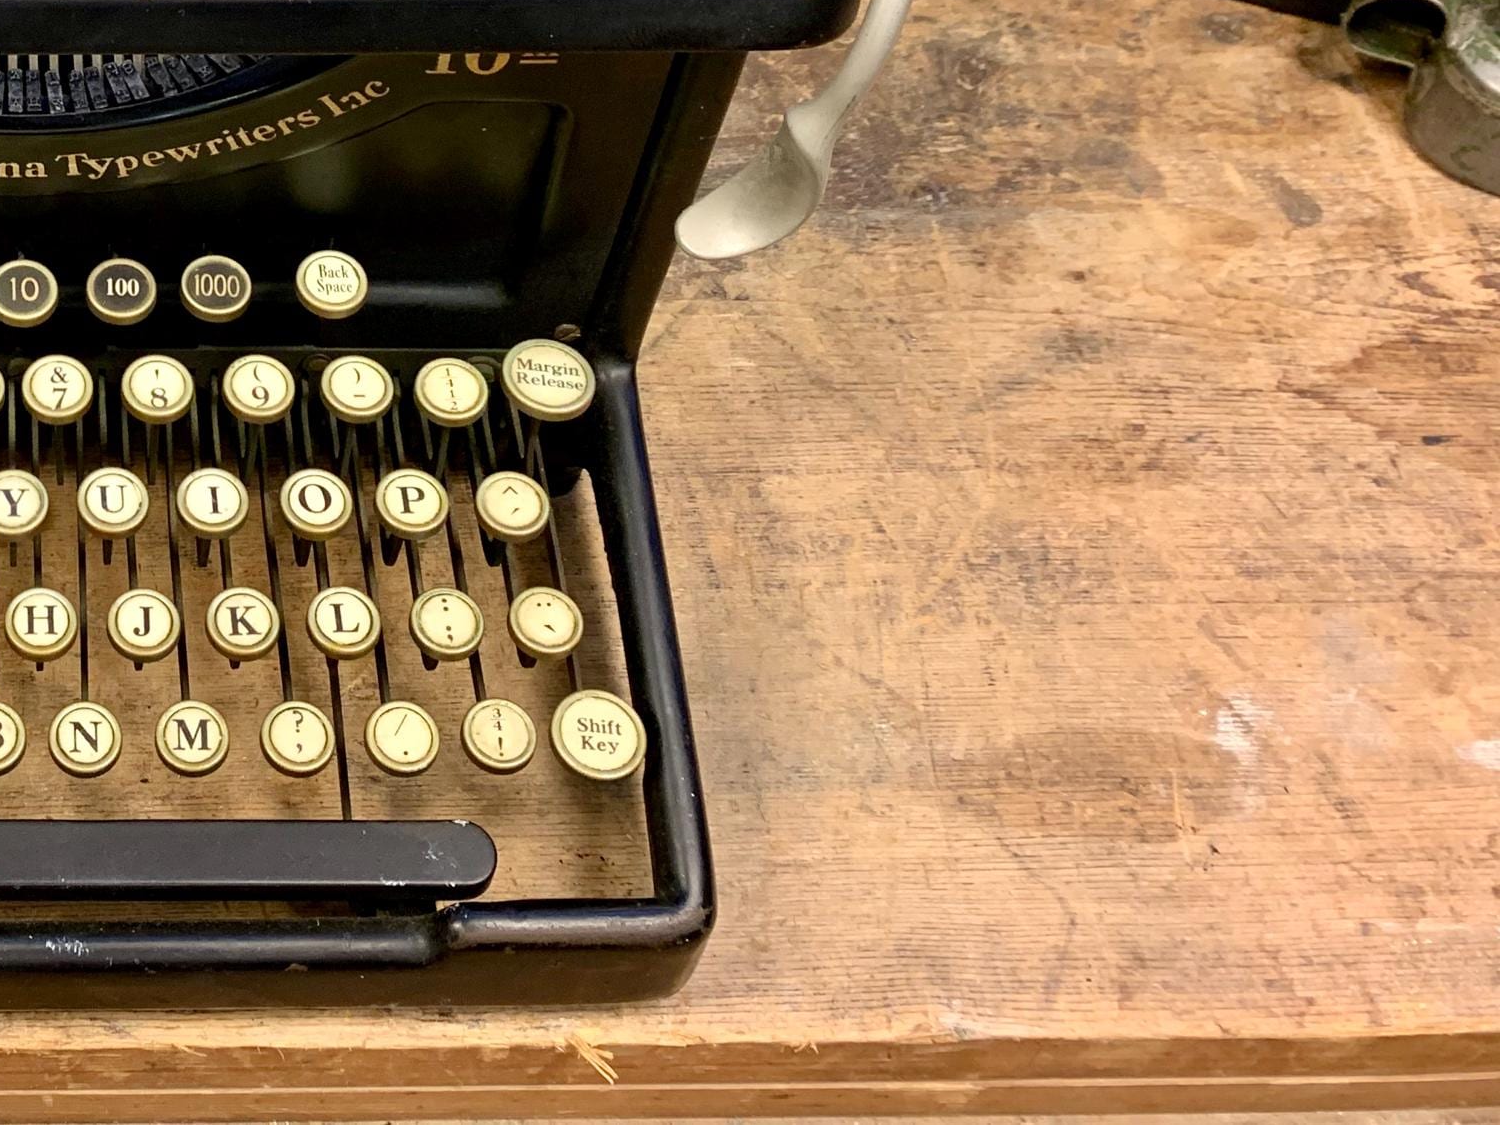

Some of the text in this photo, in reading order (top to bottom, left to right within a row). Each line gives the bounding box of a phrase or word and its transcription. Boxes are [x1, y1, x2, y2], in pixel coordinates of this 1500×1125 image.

[55, 106, 321, 180] Typewriters
[317, 78, 391, 119] Inc
[318, 263, 349, 279] Back
[9, 276, 40, 302] 10
[105, 277, 140, 297] 100
[194, 273, 241, 299] 1000
[316, 279, 353, 296] Space
[516, 357, 581, 377] Margin
[516, 372, 584, 392] Release
[51, 386, 68, 410] 7
[150, 387, 169, 409] 8
[252, 385, 270, 408] 9
[96, 484, 128, 513] U
[208, 486, 224, 515] I
[298, 483, 332, 513] O
[395, 485, 426, 515] P
[23, 605, 59, 635] H
[133, 605, 154, 637] J
[227, 605, 262, 637] K
[328, 602, 360, 634] L
[69, 721, 103, 753] N
[173, 719, 212, 751] M
[577, 717, 622, 736] Shift
[580, 736, 620, 755] Key
